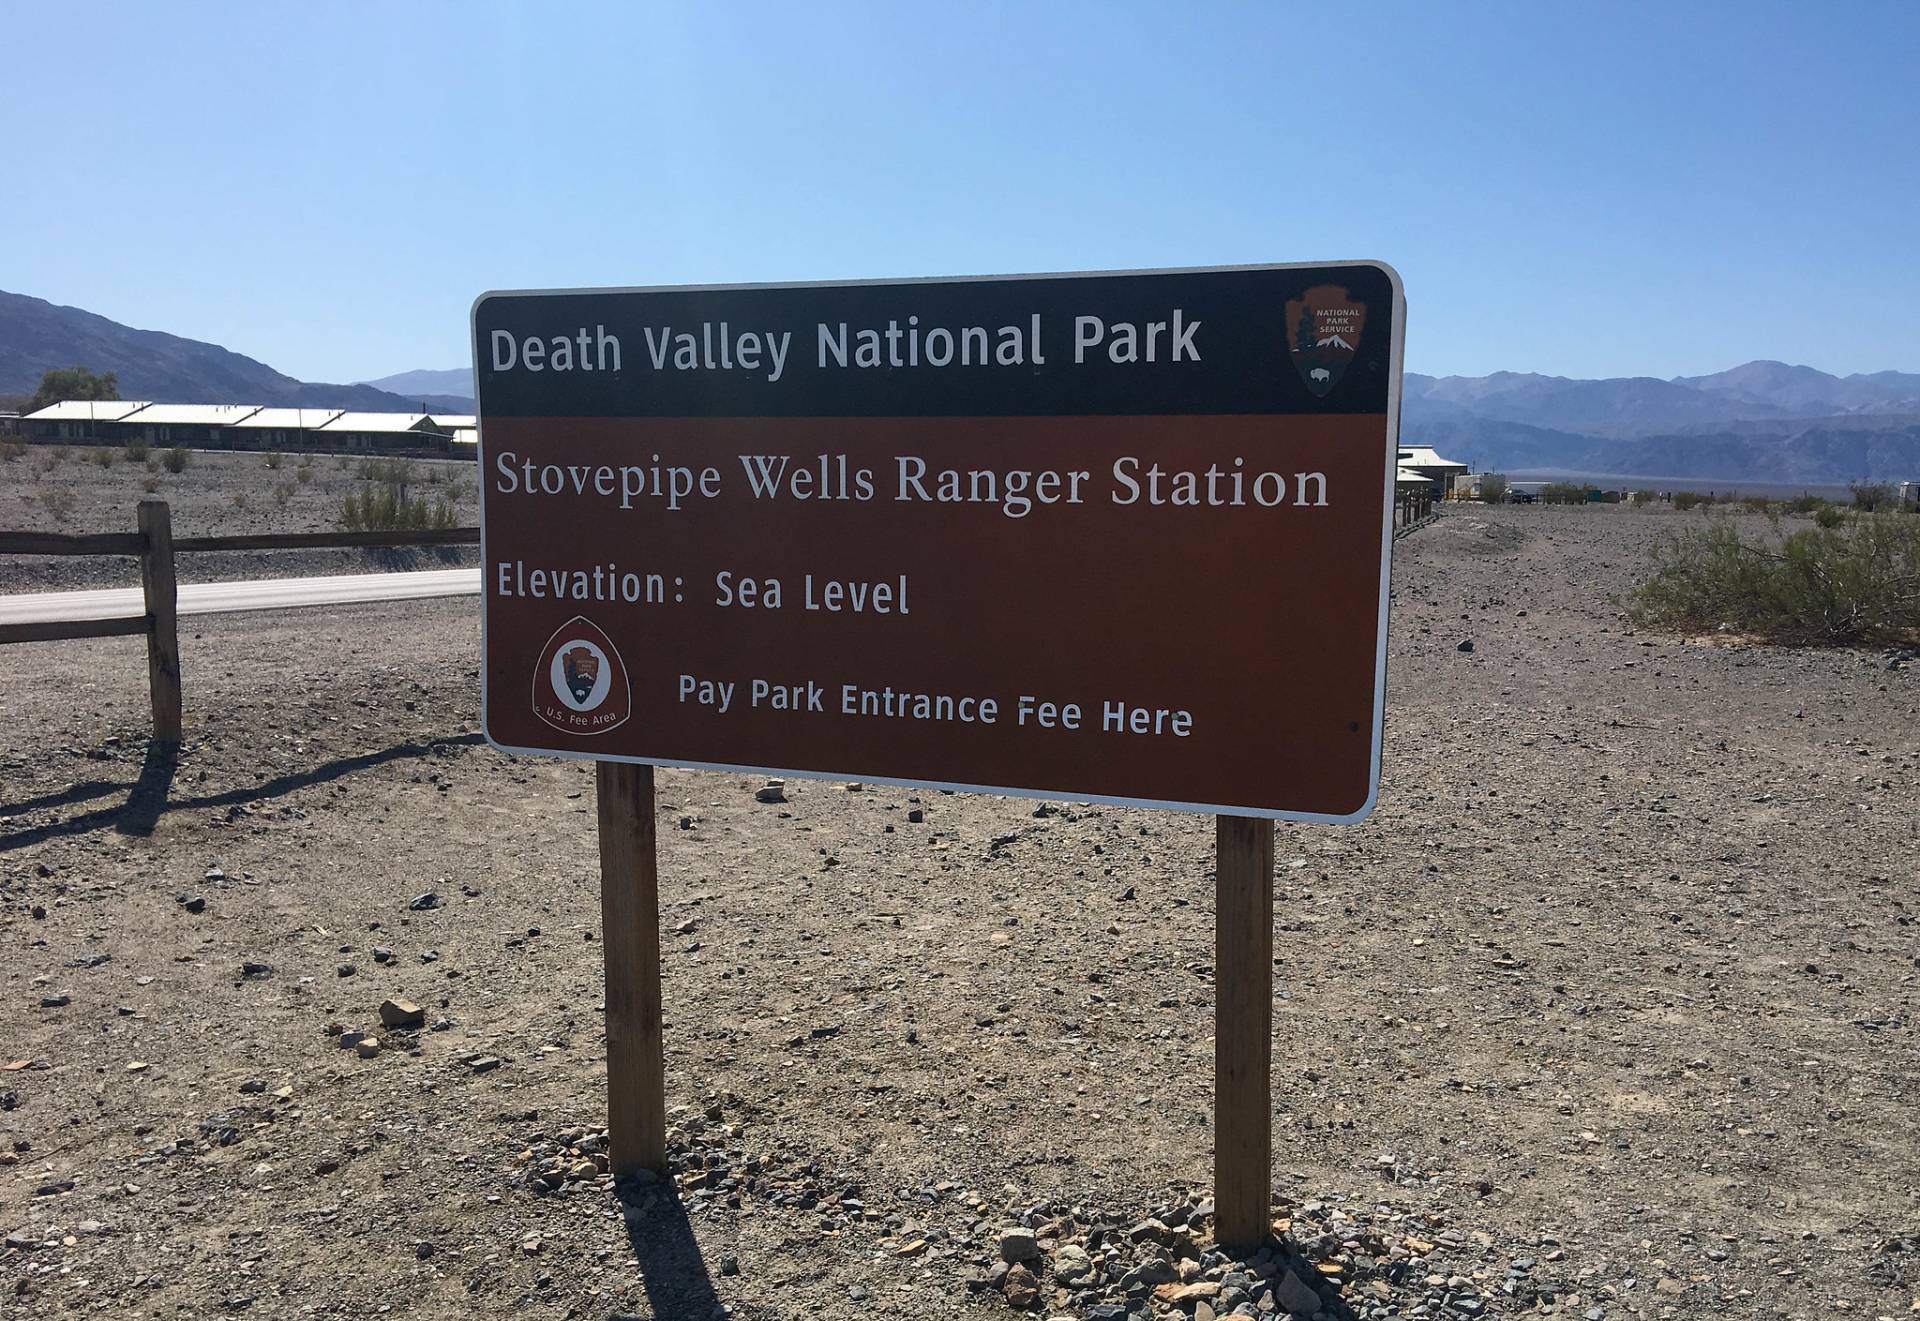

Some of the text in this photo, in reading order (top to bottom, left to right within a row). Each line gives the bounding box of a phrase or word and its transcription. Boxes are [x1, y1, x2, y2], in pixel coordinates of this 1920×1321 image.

[1316, 309, 1360, 317] NATIONAL
[1319, 325, 1355, 333] SERVICE
[1326, 317, 1349, 325] PARK
[490, 309, 1202, 382] Death Valley National Park
[496, 452, 1329, 518] Stovepipe Wells Ranger Station
[499, 560, 909, 615] Elevation: Sea Level
[546, 706, 617, 726] U.S. Fee Area
[678, 674, 1193, 737] Pay Park Entrance Fee Here
